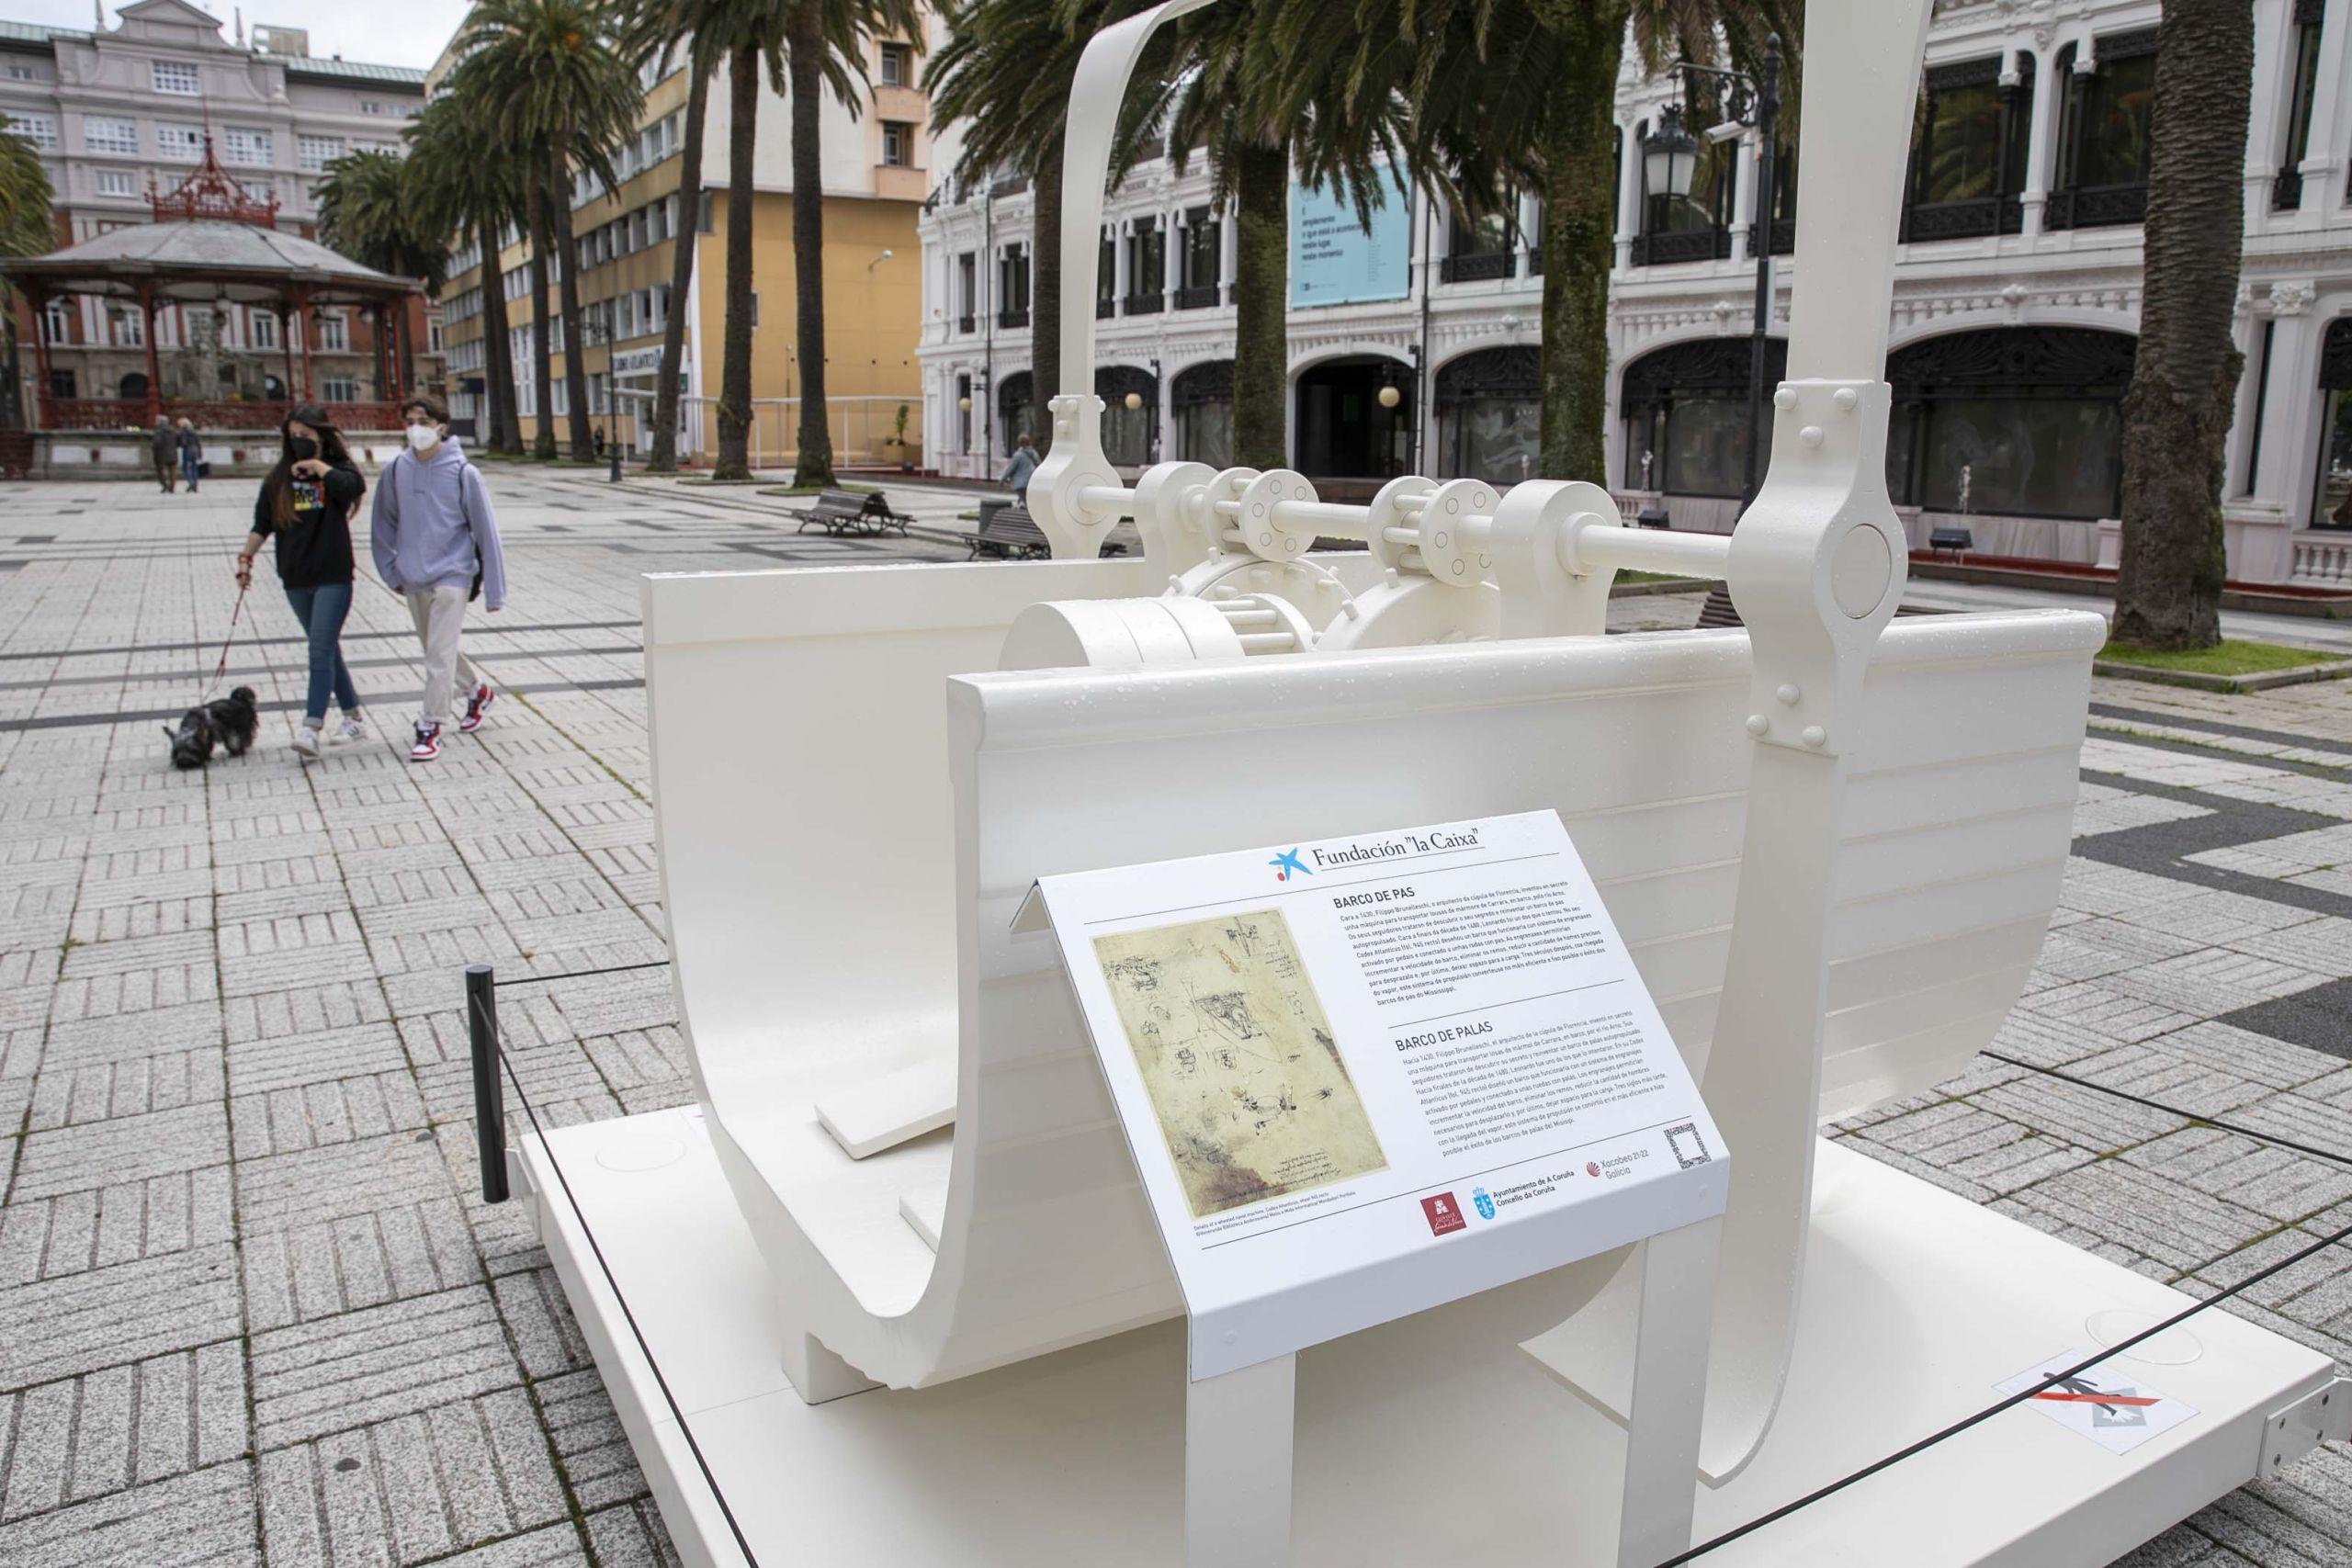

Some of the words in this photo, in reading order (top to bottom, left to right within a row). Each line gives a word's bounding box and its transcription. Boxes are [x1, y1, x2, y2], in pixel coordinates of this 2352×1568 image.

[1312, 840, 1407, 865] Fundación
[1333, 893, 1374, 908] BARCO
[1374, 890, 1392, 902] DE
[1392, 887, 1415, 899] PAS
[1361, 959, 1385, 968] activado
[1396, 953, 1414, 963] pedais
[1419, 948, 1447, 957] conectado
[1364, 966, 1399, 977] incrementar
[1405, 960, 1433, 969] velocidade
[1472, 967, 1504, 977] converteuse
[1369, 980, 1382, 988] para
[1383, 974, 1414, 984] desprazalo
[1376, 998, 1396, 1006] barcos
[1395, 1033, 1436, 1051] BARCO
[1437, 1029, 1455, 1042] DE
[1455, 1021, 1493, 1038] PALAS
[1600, 1155, 1633, 1169] Xacobeo
[1605, 1167, 1631, 1179] Galicia
[1493, 1181, 1537, 1199] Ayuntamiento
[1552, 1170, 1575, 1181] Coruña
[1496, 1194, 1523, 1207] Concello
[1532, 1186, 1555, 1196] Coruña
